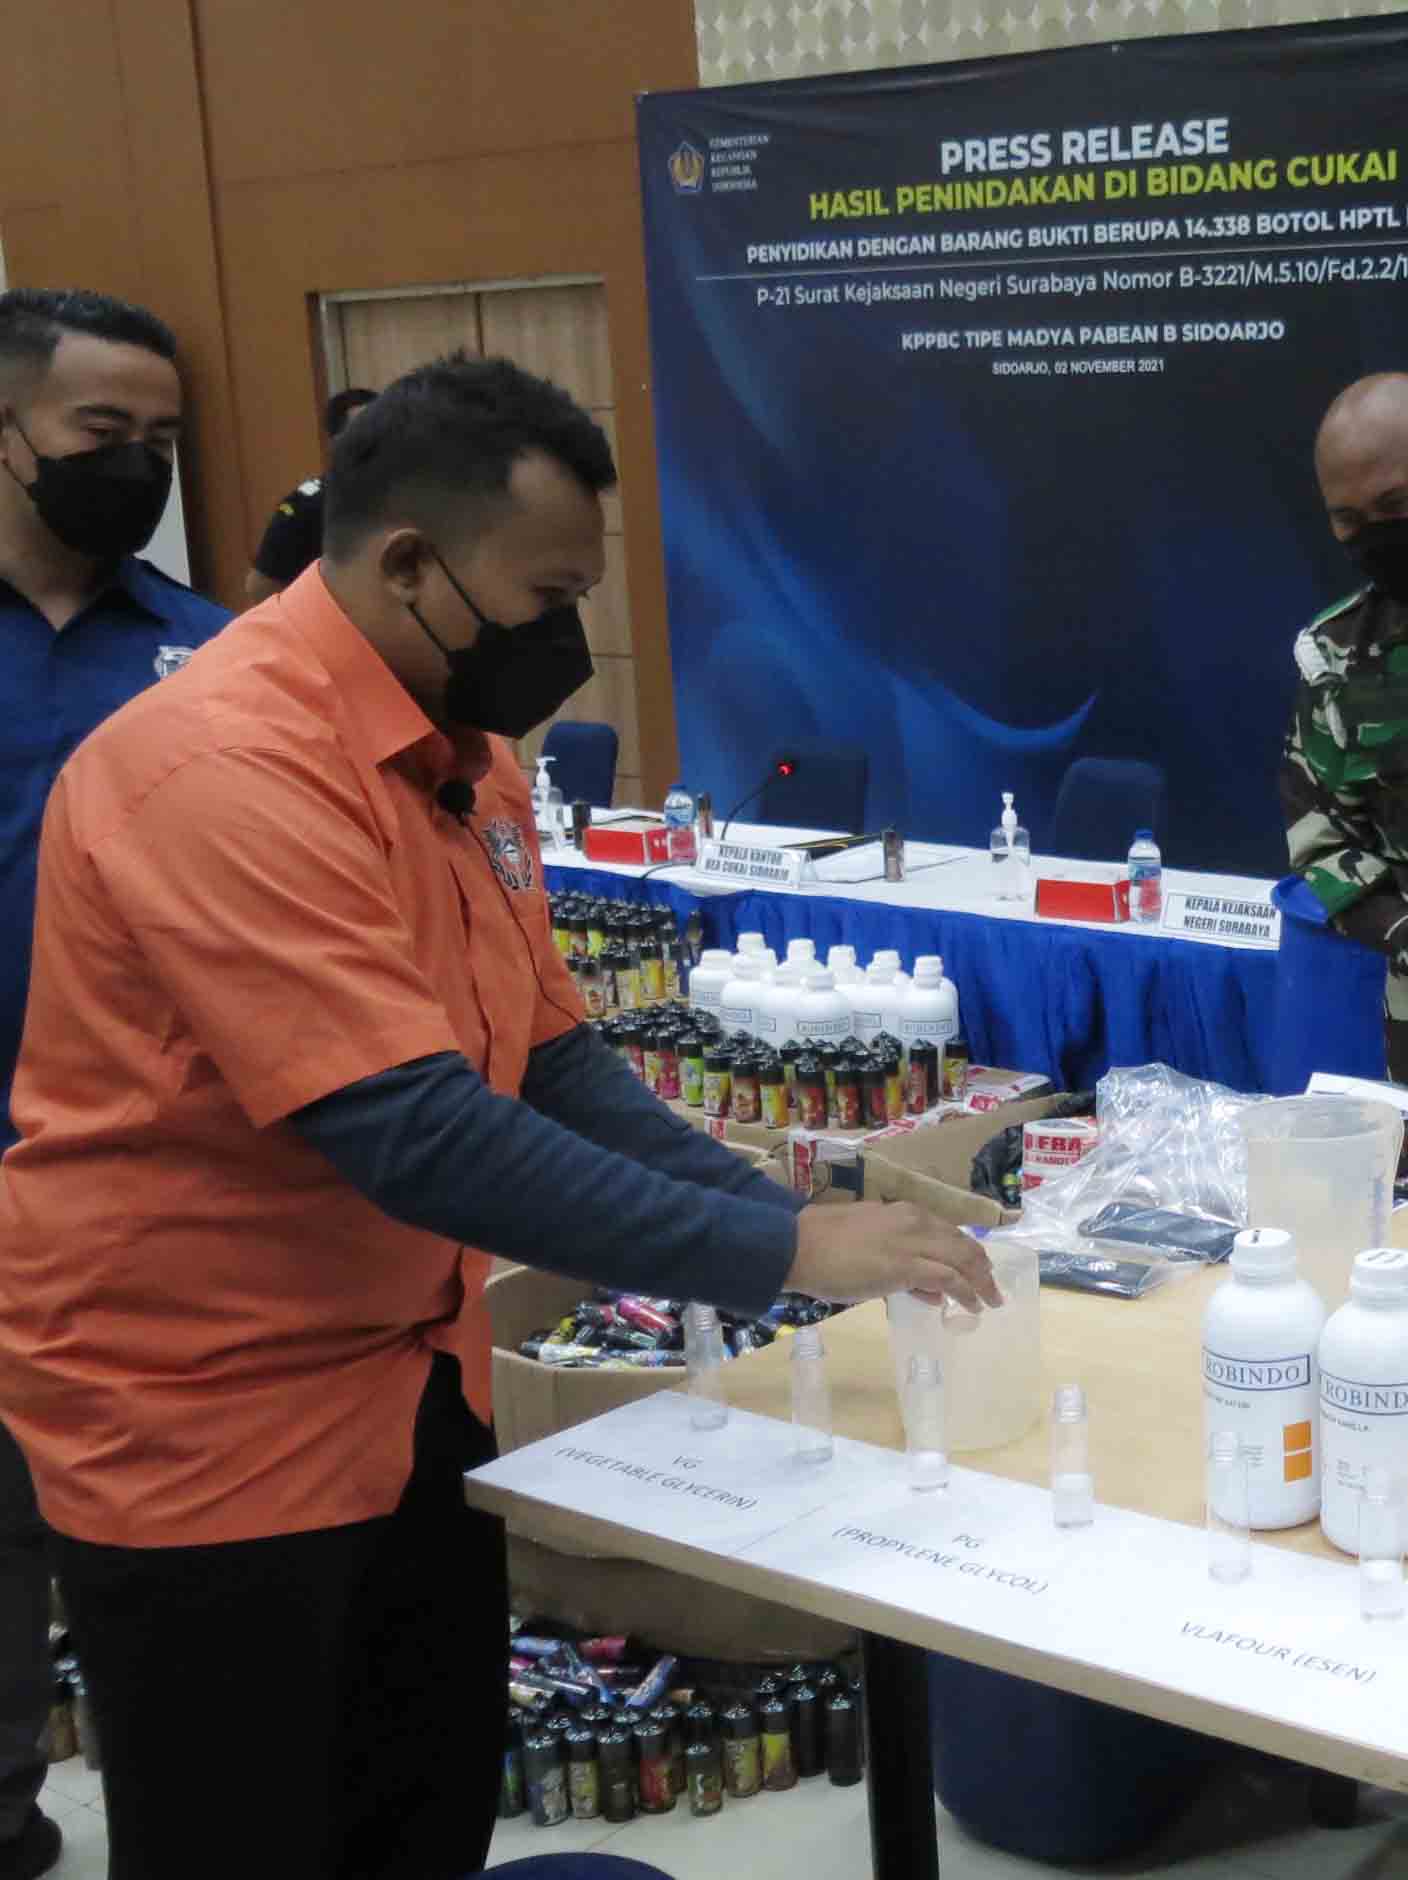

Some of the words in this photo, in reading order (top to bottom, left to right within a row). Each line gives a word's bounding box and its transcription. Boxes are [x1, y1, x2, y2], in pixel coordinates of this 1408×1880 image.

[940, 134, 1051, 174] PRESS
[1062, 117, 1229, 165] RELEASE
[809, 188, 889, 220] HASIL
[897, 172, 1096, 214] PENINDAKAN
[1104, 168, 1137, 199] DI
[1147, 159, 1278, 196] BIDANG
[1287, 149, 1398, 188] CUKAI
[747, 240, 852, 264] PENYIDIKAN
[858, 233, 935, 258] DENGAN
[940, 228, 1023, 252] BARANG
[1028, 224, 1088, 247] BUKTI
[1093, 219, 1180, 244] BERUPA
[1184, 214, 1250, 238] 14.338
[1256, 210, 1334, 235] BOTOL
[1339, 205, 1401, 230] HPTL
[757, 286, 790, 306] P-21
[794, 284, 841, 304] Surat
[845, 279, 934, 306] Kejaksaan
[940, 276, 1001, 301] Negeri
[1006, 271, 1097, 297] Surabaya
[1103, 269, 1174, 290] Nomor
[902, 330, 960, 351] KPPBC
[965, 329, 1002, 348] TIPE
[1006, 326, 1075, 347] MADYA
[1080, 324, 1158, 345] PABEAN
[1163, 323, 1178, 342] B
[1182, 320, 1285, 343] SIDOARJO
[992, 360, 1051, 376] SIDOARJO,
[1054, 360, 1068, 374] 02
[1070, 359, 1135, 374] NOVEMBER
[1138, 358, 1165, 373] 2021
[1183, 915, 1217, 931] NEGERI
[1218, 919, 1270, 937] SURABAYA
[1184, 896, 1220, 913] KEPALA
[1221, 900, 1276, 920] KEJAKSAAN
[553, 1446, 664, 1482] (VEGETABLE
[660, 1476, 758, 1511] GLYCERIN)
[671, 1454, 704, 1470] VG
[952, 1533, 983, 1549] PG
[832, 1526, 961, 1568] (PROPYLENE
[958, 1561, 1049, 1594] GLYCOL)
[1180, 1620, 1291, 1661] VLAFOUR
[1292, 1651, 1377, 1684] (ESEN)
